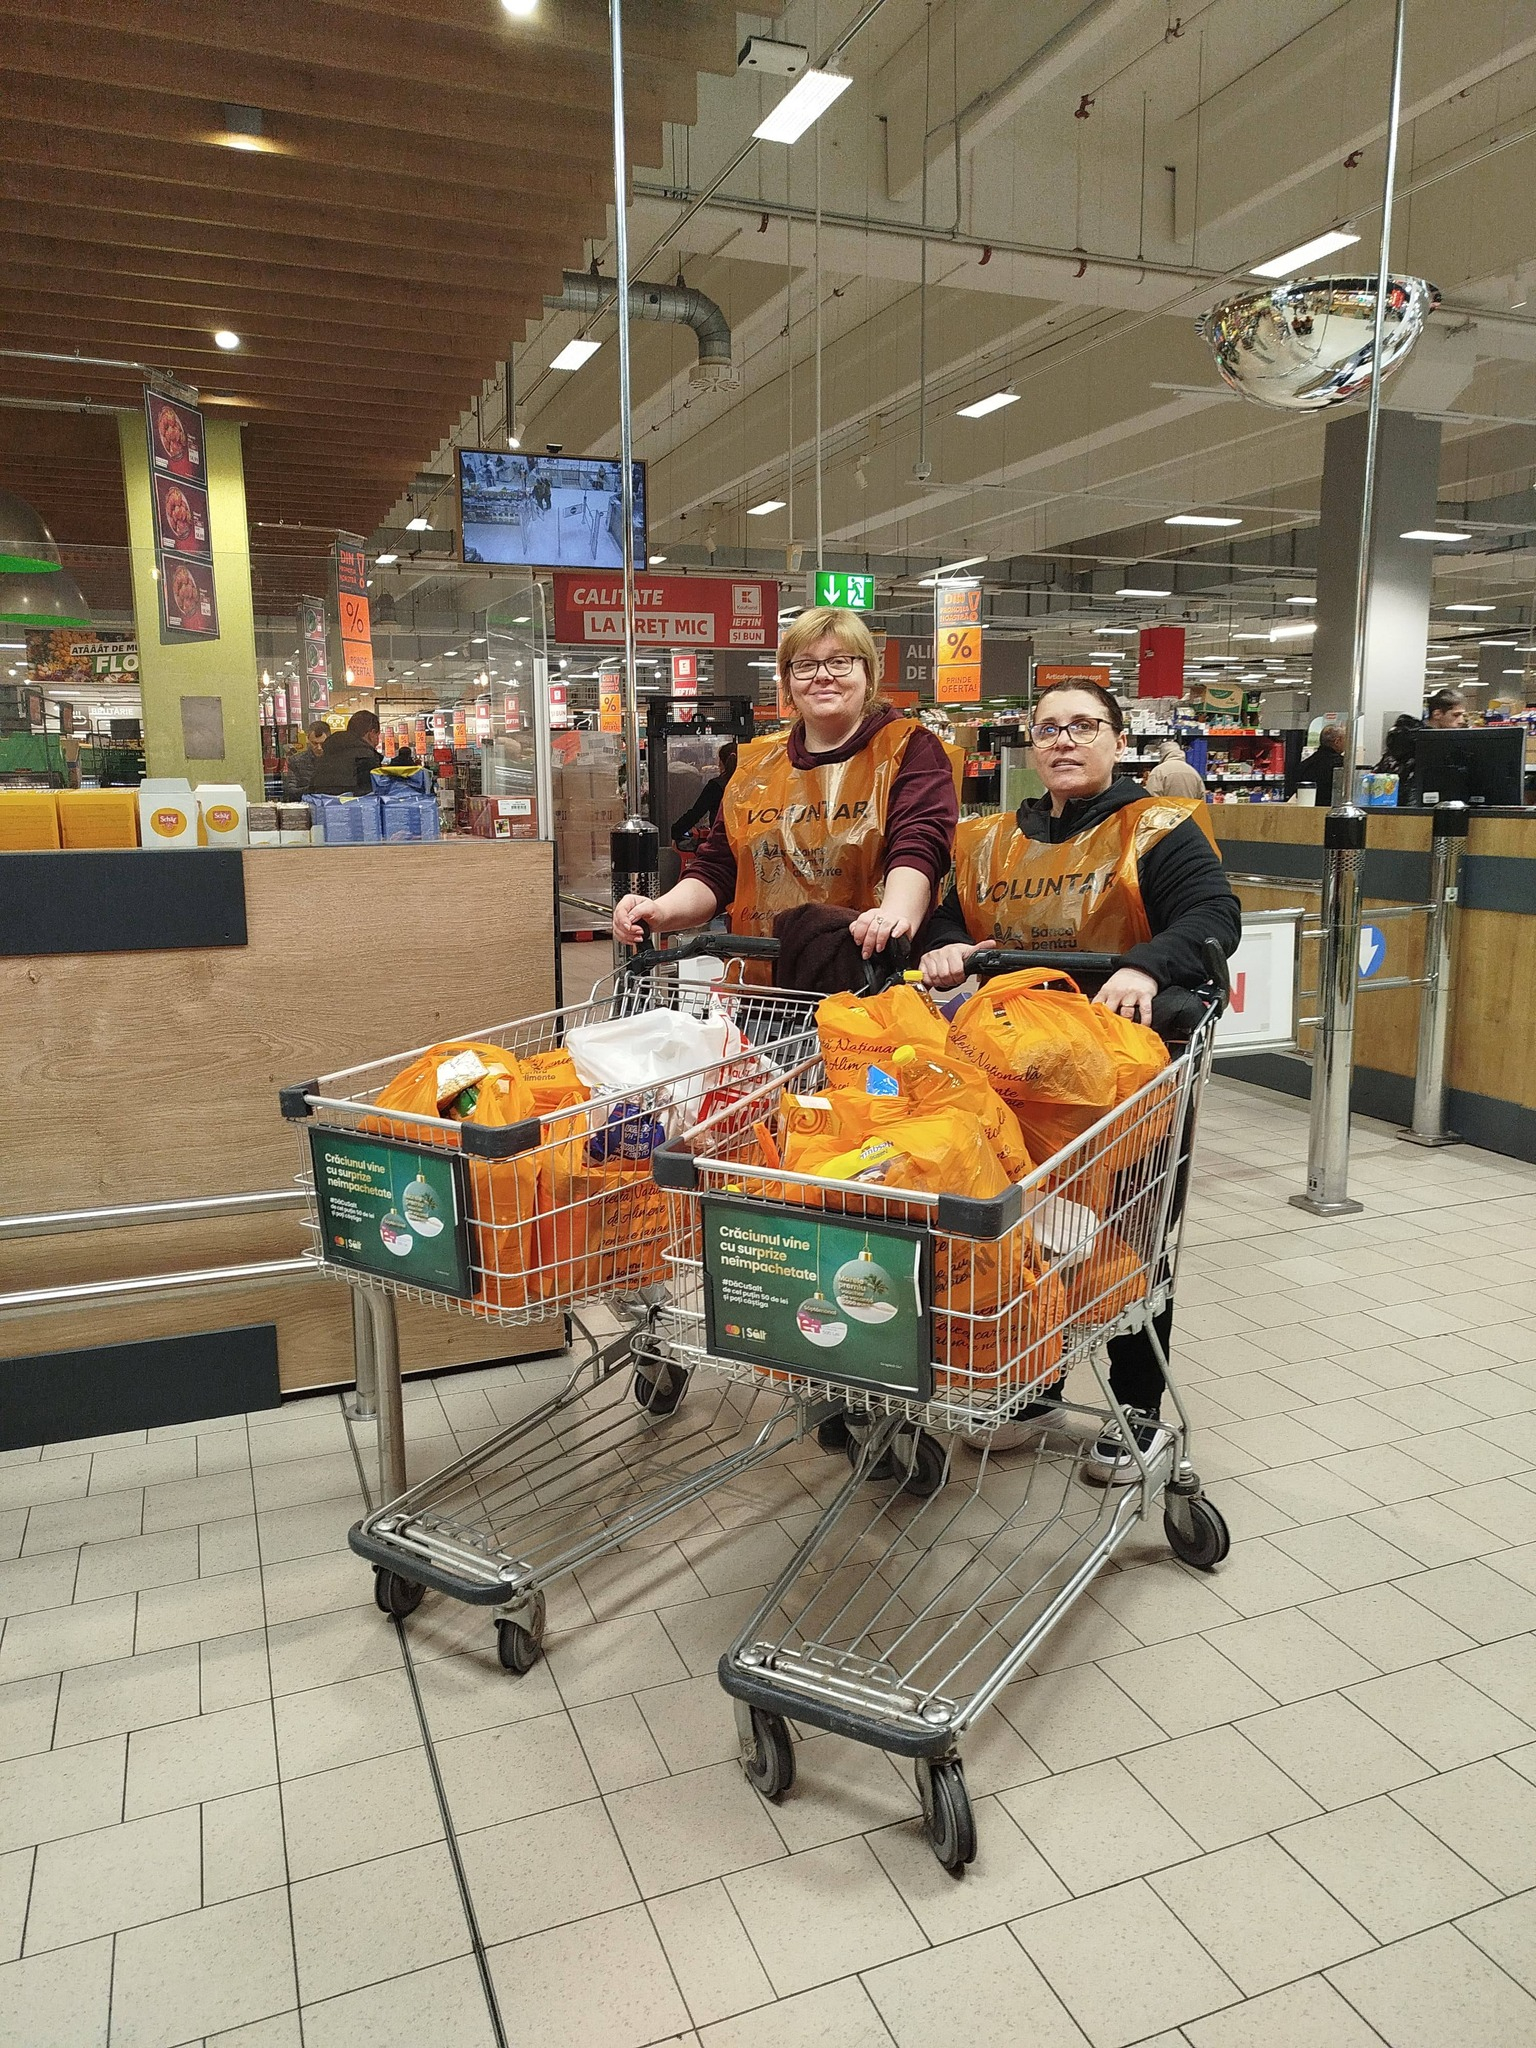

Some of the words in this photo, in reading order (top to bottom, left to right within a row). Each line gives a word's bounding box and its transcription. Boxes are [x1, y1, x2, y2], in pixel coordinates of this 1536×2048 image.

[591, 617, 616, 633] LA
[675, 619, 707, 636] MIC
[732, 618, 762, 627] IEFTIN
[743, 633, 761, 641] BUN
[947, 632, 972, 659] %
[906, 666, 927, 680] DE
[946, 676, 971, 684] PRINDE
[941, 684, 977, 693] OFERTA!
[976, 872, 1118, 902] VOLUNTAR
[1031, 938, 1077, 950] pentru
[325, 1153, 366, 1170] Crăciunul
[367, 1161, 385, 1174] vine
[326, 1166, 338, 1175] cu
[338, 1168, 372, 1182] surprize
[327, 1177, 392, 1199] neîmpachetate
[720, 1226, 780, 1246] Crăciunul
[782, 1236, 810, 1251] vine
[720, 1241, 736, 1252] cu
[737, 1244, 787, 1261] surprize
[721, 1255, 817, 1281] neîmpachetate
[742, 1291, 761, 1300] puțin
[761, 1293, 770, 1301] 50
[770, 1295, 780, 1303] de
[780, 1297, 789, 1305] lei
